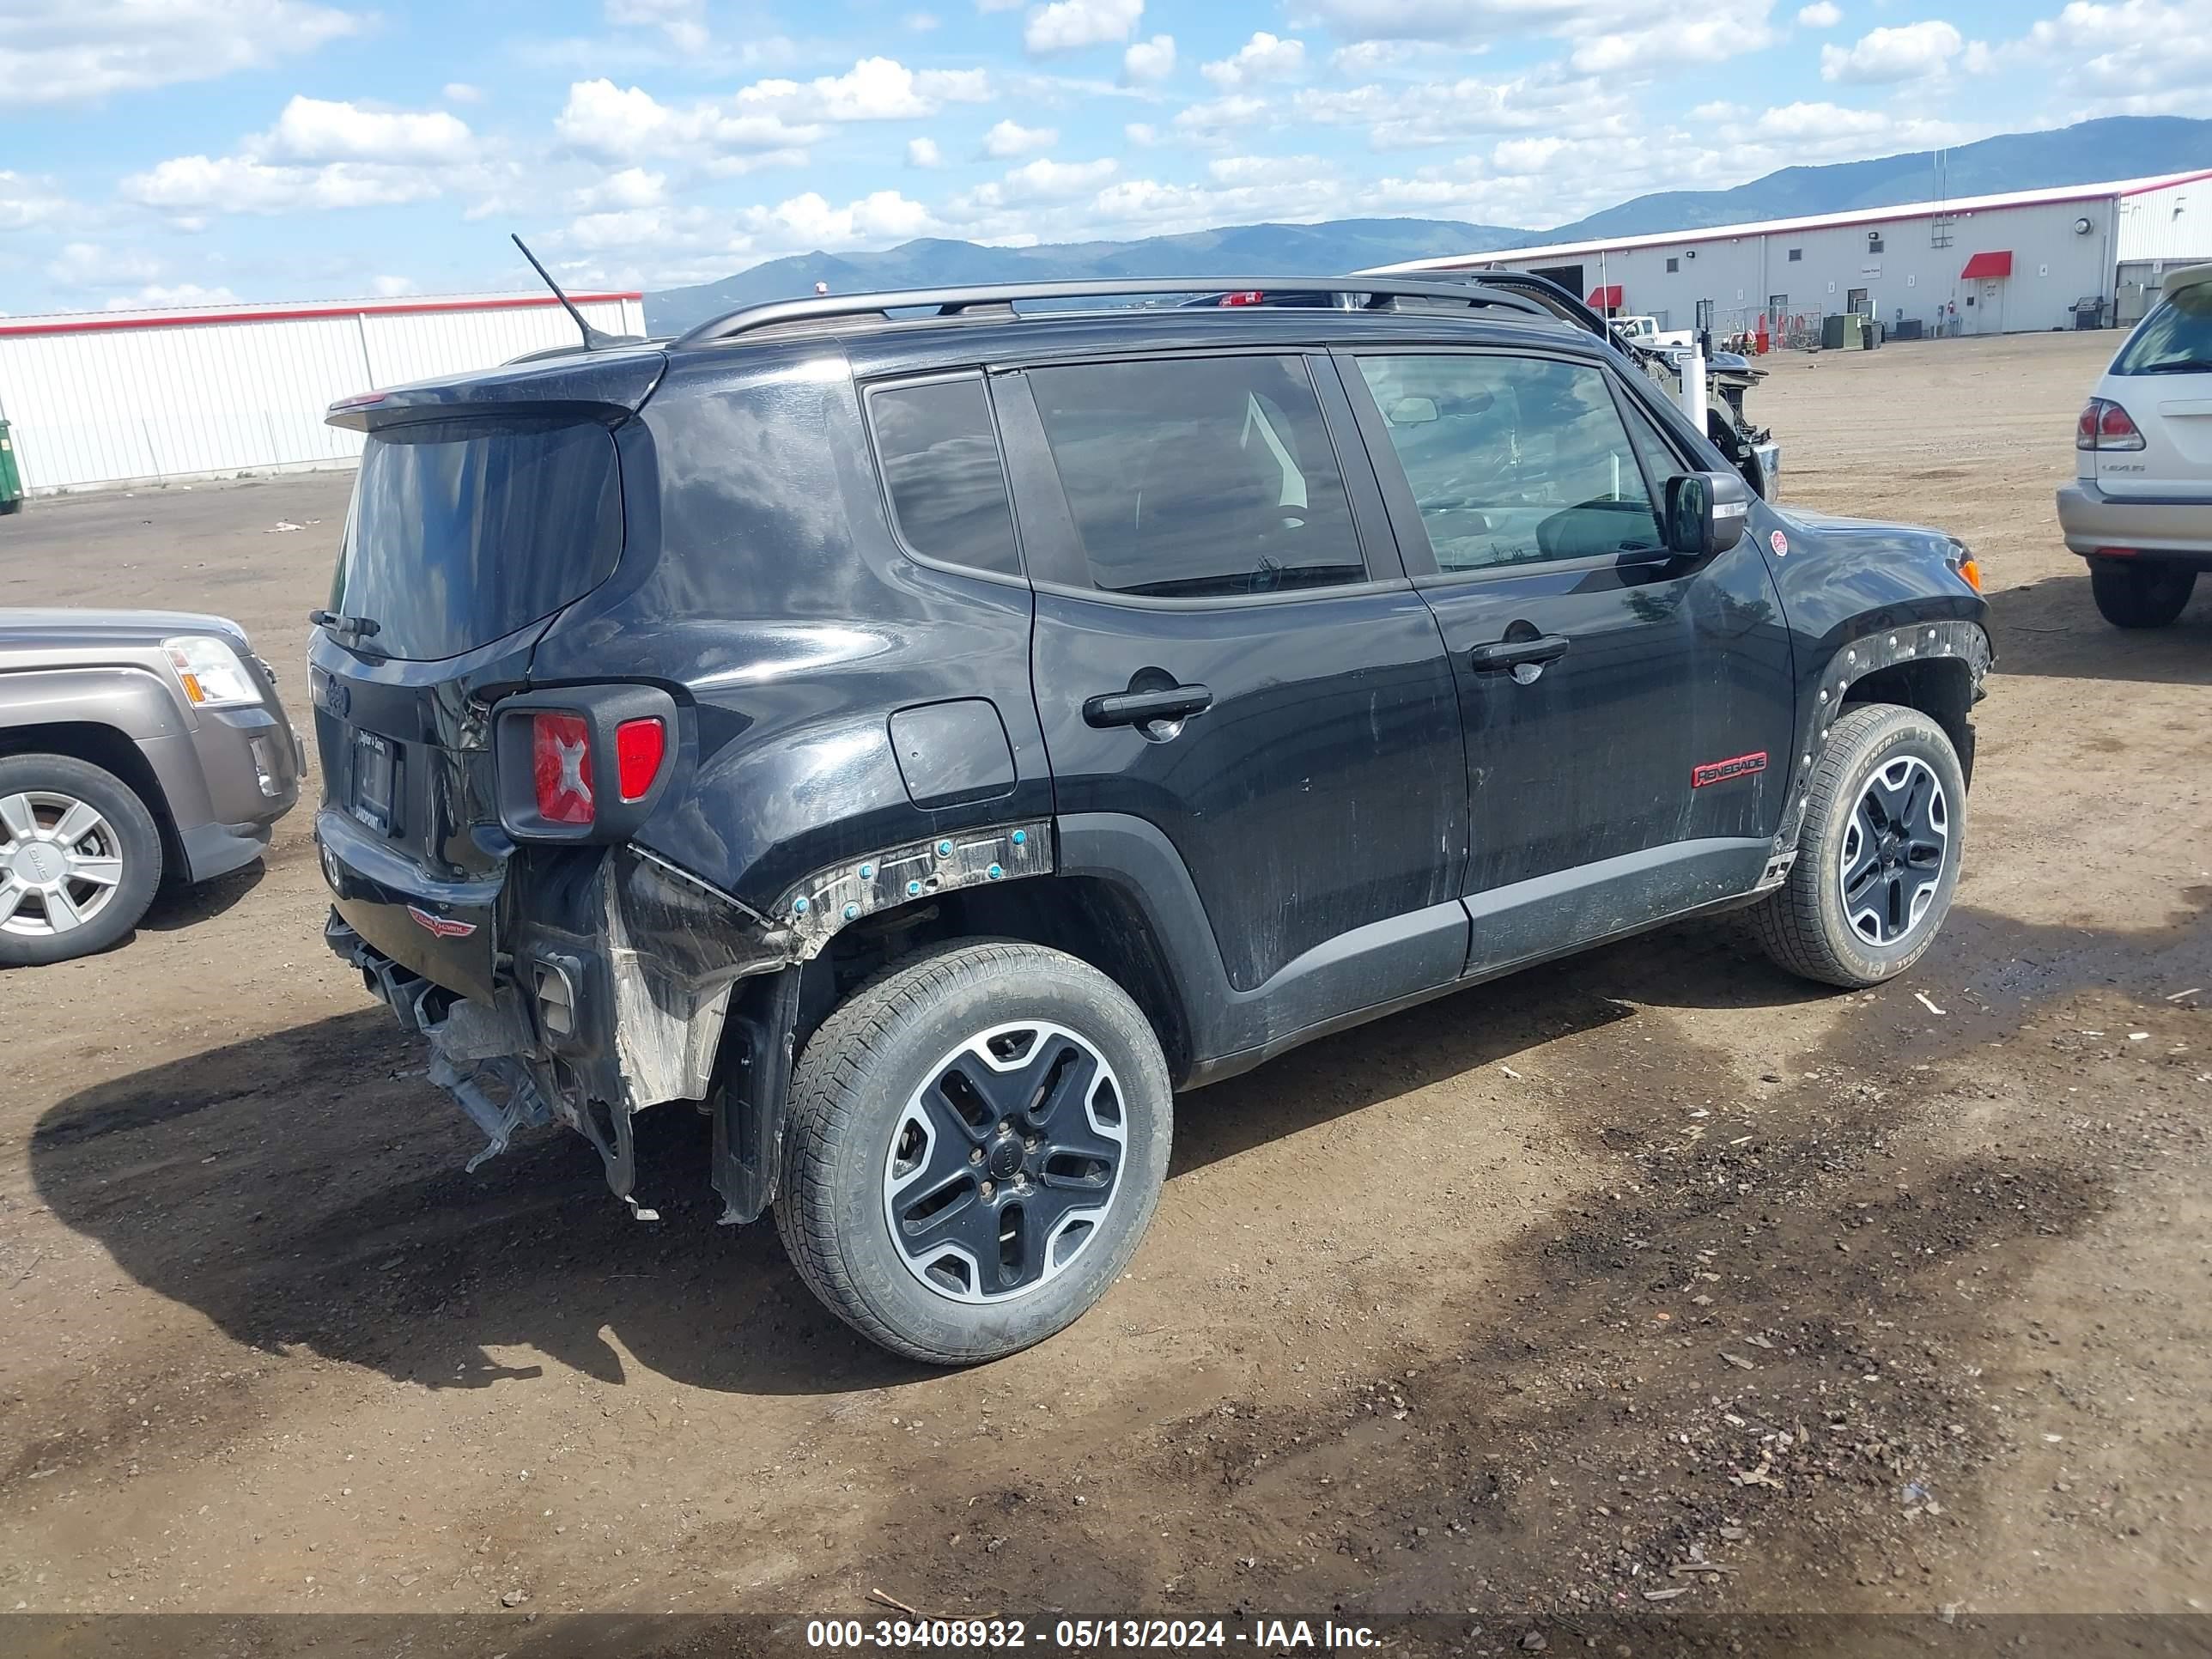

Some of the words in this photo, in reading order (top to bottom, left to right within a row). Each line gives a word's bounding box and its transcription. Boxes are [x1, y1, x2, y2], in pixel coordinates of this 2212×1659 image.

[325, 674, 350, 718] Jeep
[1697, 756, 1765, 783] RENEGADE
[1858, 731, 1906, 778] GENERAL
[355, 804, 379, 831] SANDPOINT
[28, 848, 50, 881] GMC
[1896, 920, 1941, 969] GENERAL
[1087, 996, 1149, 1079] GENERAL
[1003, 1145, 1013, 1173] Jeep
